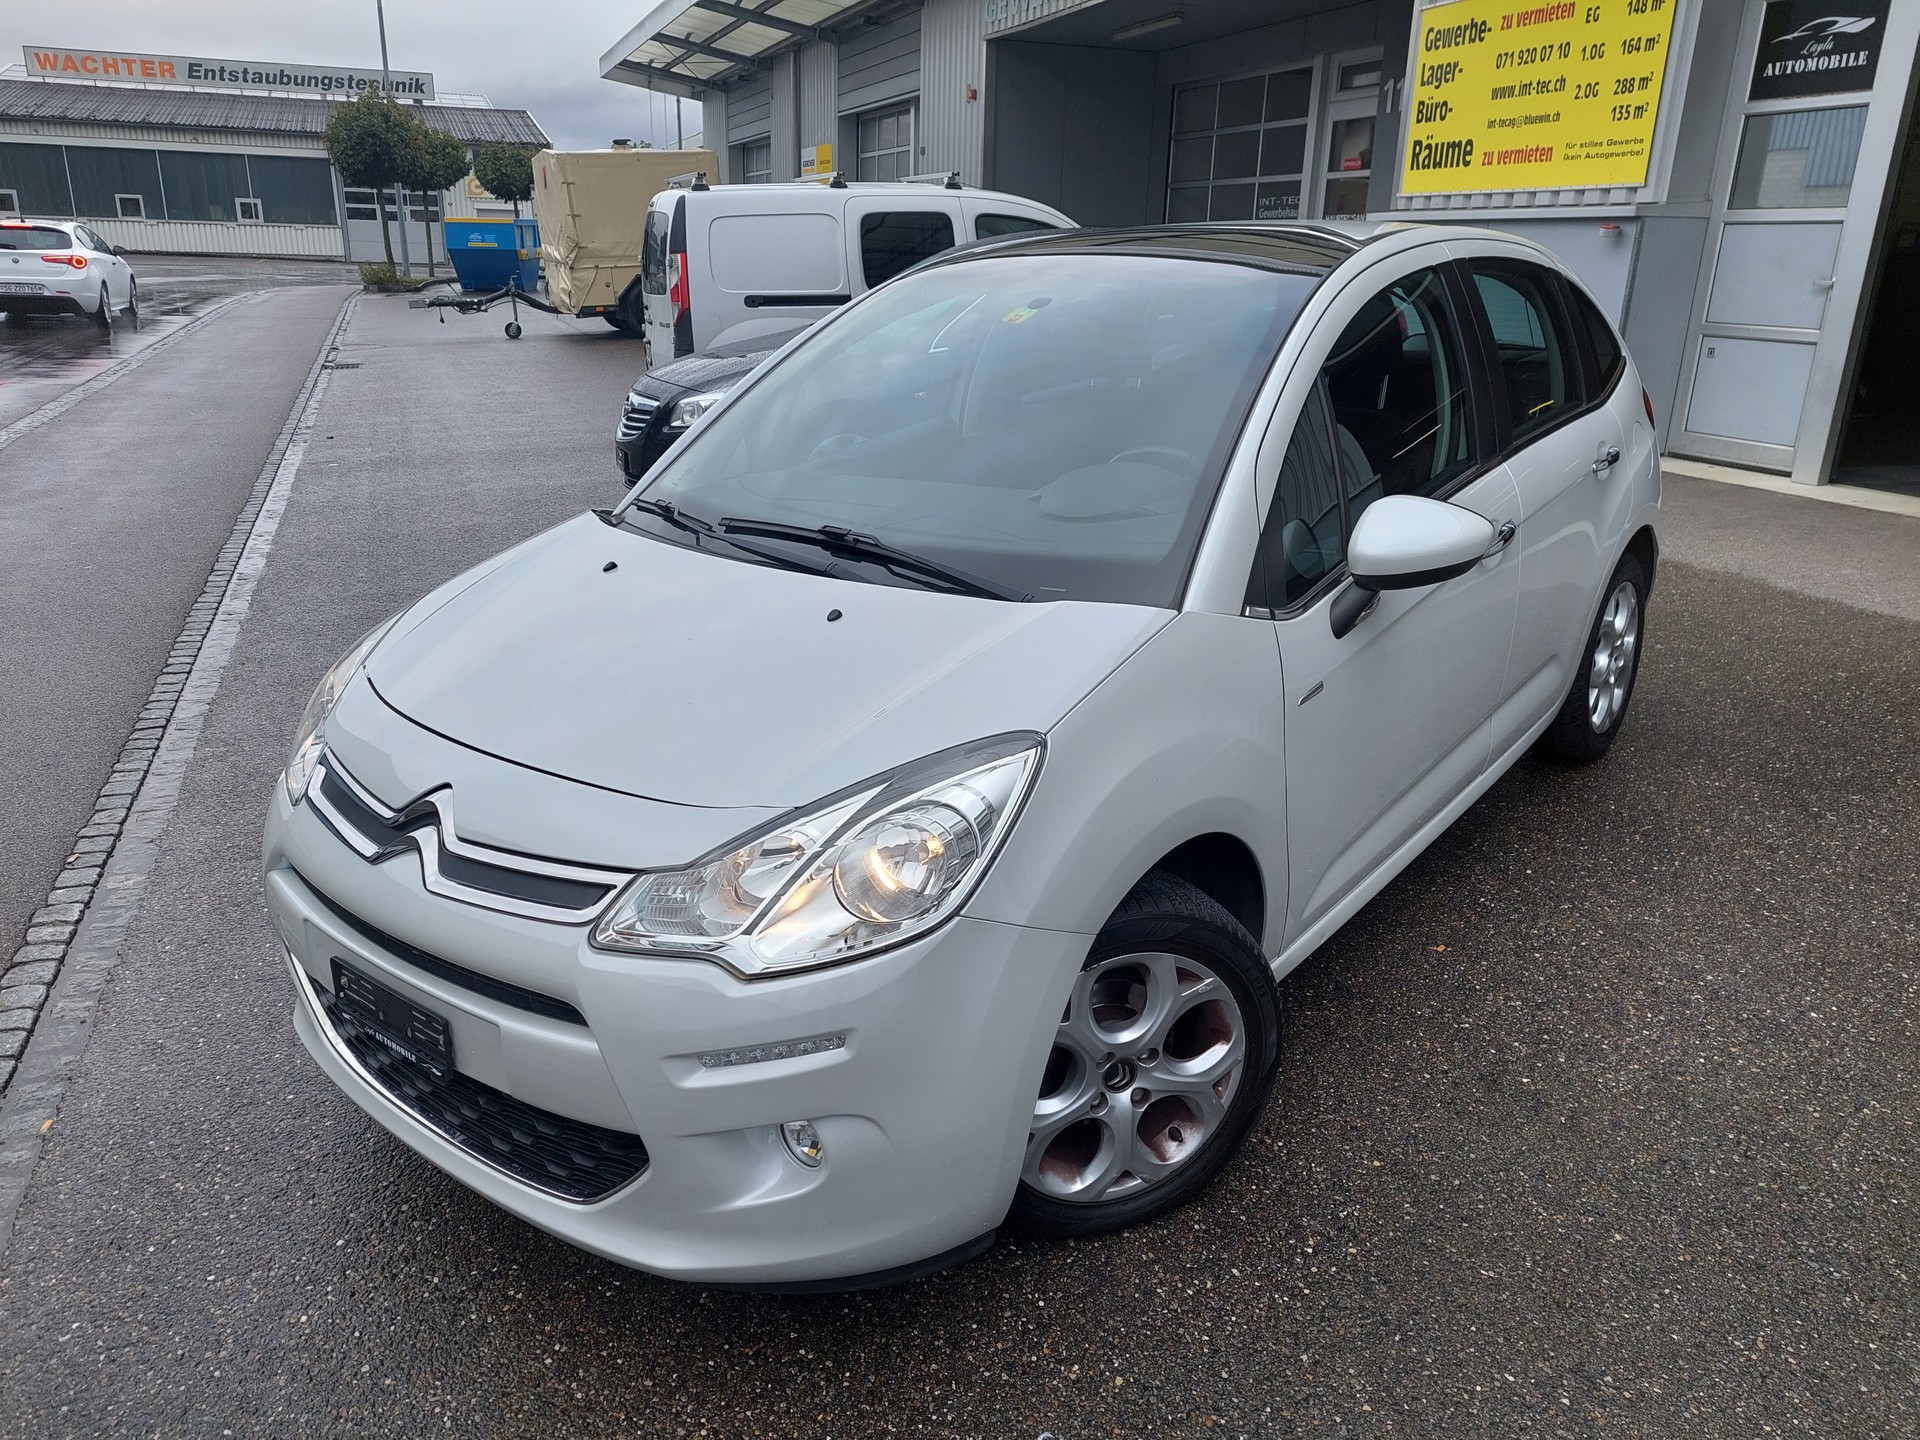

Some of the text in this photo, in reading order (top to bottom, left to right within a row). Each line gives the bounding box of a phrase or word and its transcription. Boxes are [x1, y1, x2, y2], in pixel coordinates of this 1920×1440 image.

[1500, 0, 1576, 31] zu vermieten
[1585, 6, 1600, 24] EG
[1627, 0, 1648, 16] 148
[1425, 17, 1492, 52] Gewerbe-
[1621, 36, 1642, 55] 164
[1801, 35, 1834, 57] Layla
[33, 52, 176, 79] WACHTER
[1496, 41, 1571, 70] 071 920 07 10
[1763, 50, 1869, 77] AUTOMOBILE
[1420, 59, 1463, 90] Lager-
[1491, 74, 1567, 101] www.int-tec.ch
[1613, 77, 1636, 96] 288
[1415, 96, 1453, 124] Büro-
[1487, 111, 1561, 130] int-tecag@bluewin.ch
[1610, 104, 1632, 122] 135
[1410, 134, 1474, 171] Räume
[1563, 148, 1644, 161] (kein Autogewerbe)
[1565, 137, 1645, 150] für stilles Gewerbe
[1481, 144, 1554, 167] zu vermieten
[1259, 207, 1300, 219] Gewerbehau
[375, 1031, 417, 1063] AUTOMOBILE
